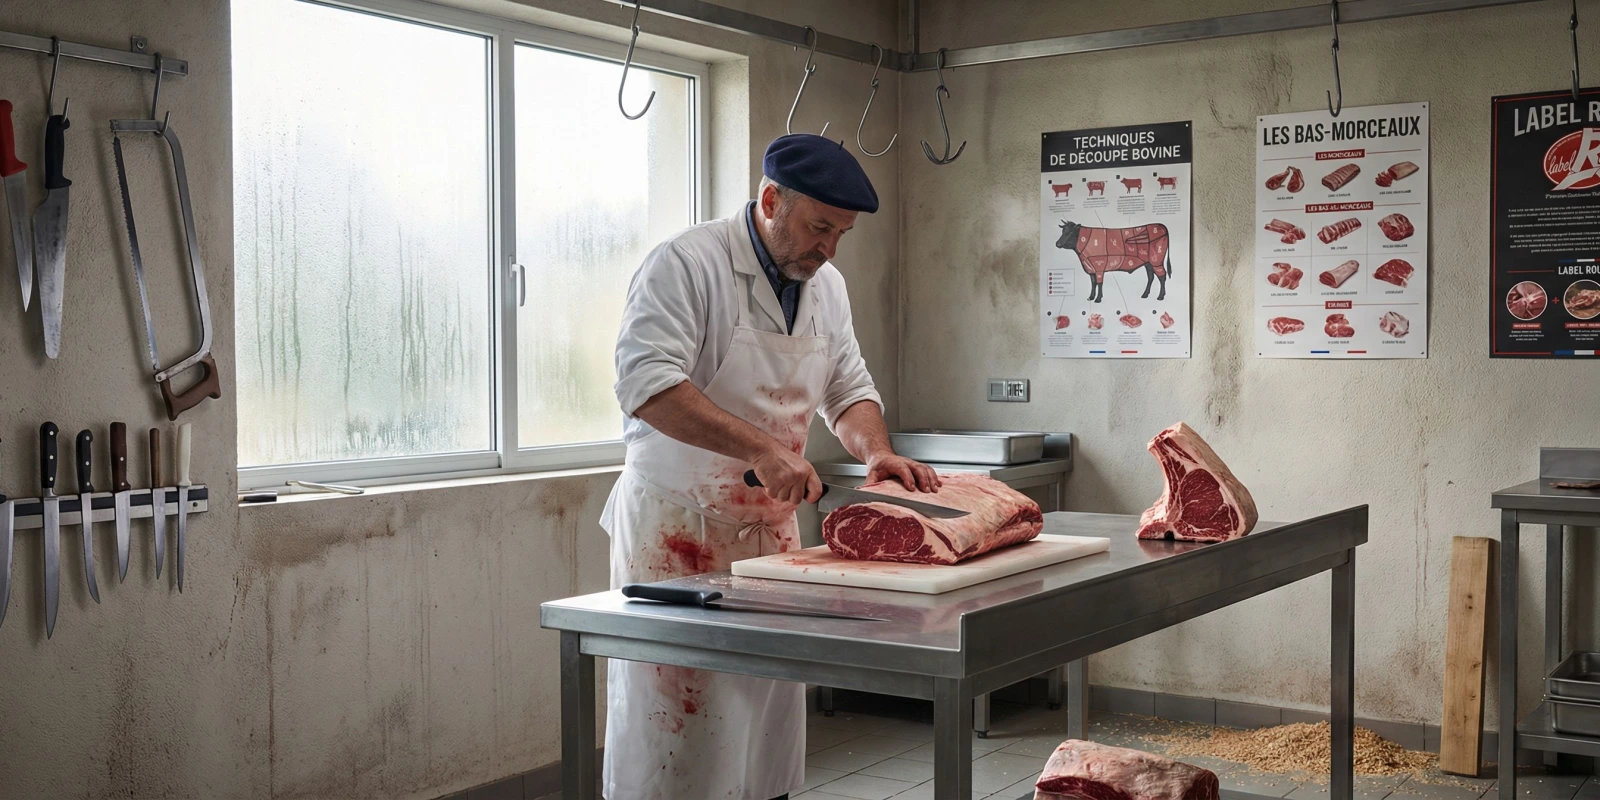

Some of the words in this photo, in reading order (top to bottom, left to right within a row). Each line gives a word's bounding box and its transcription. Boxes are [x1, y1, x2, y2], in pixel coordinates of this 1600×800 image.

[1263, 126, 1290, 146] LES
[1294, 116, 1421, 144] BAS-MORCEAUX
[1514, 102, 1581, 137] LABEL
[1073, 131, 1155, 149] TECHNIQUES
[1050, 153, 1066, 166] DE
[1069, 148, 1129, 165] DÉCOUPE
[1132, 145, 1181, 160] BOVINE
[1548, 150, 1577, 175] label
[1558, 265, 1584, 275] LABEL
